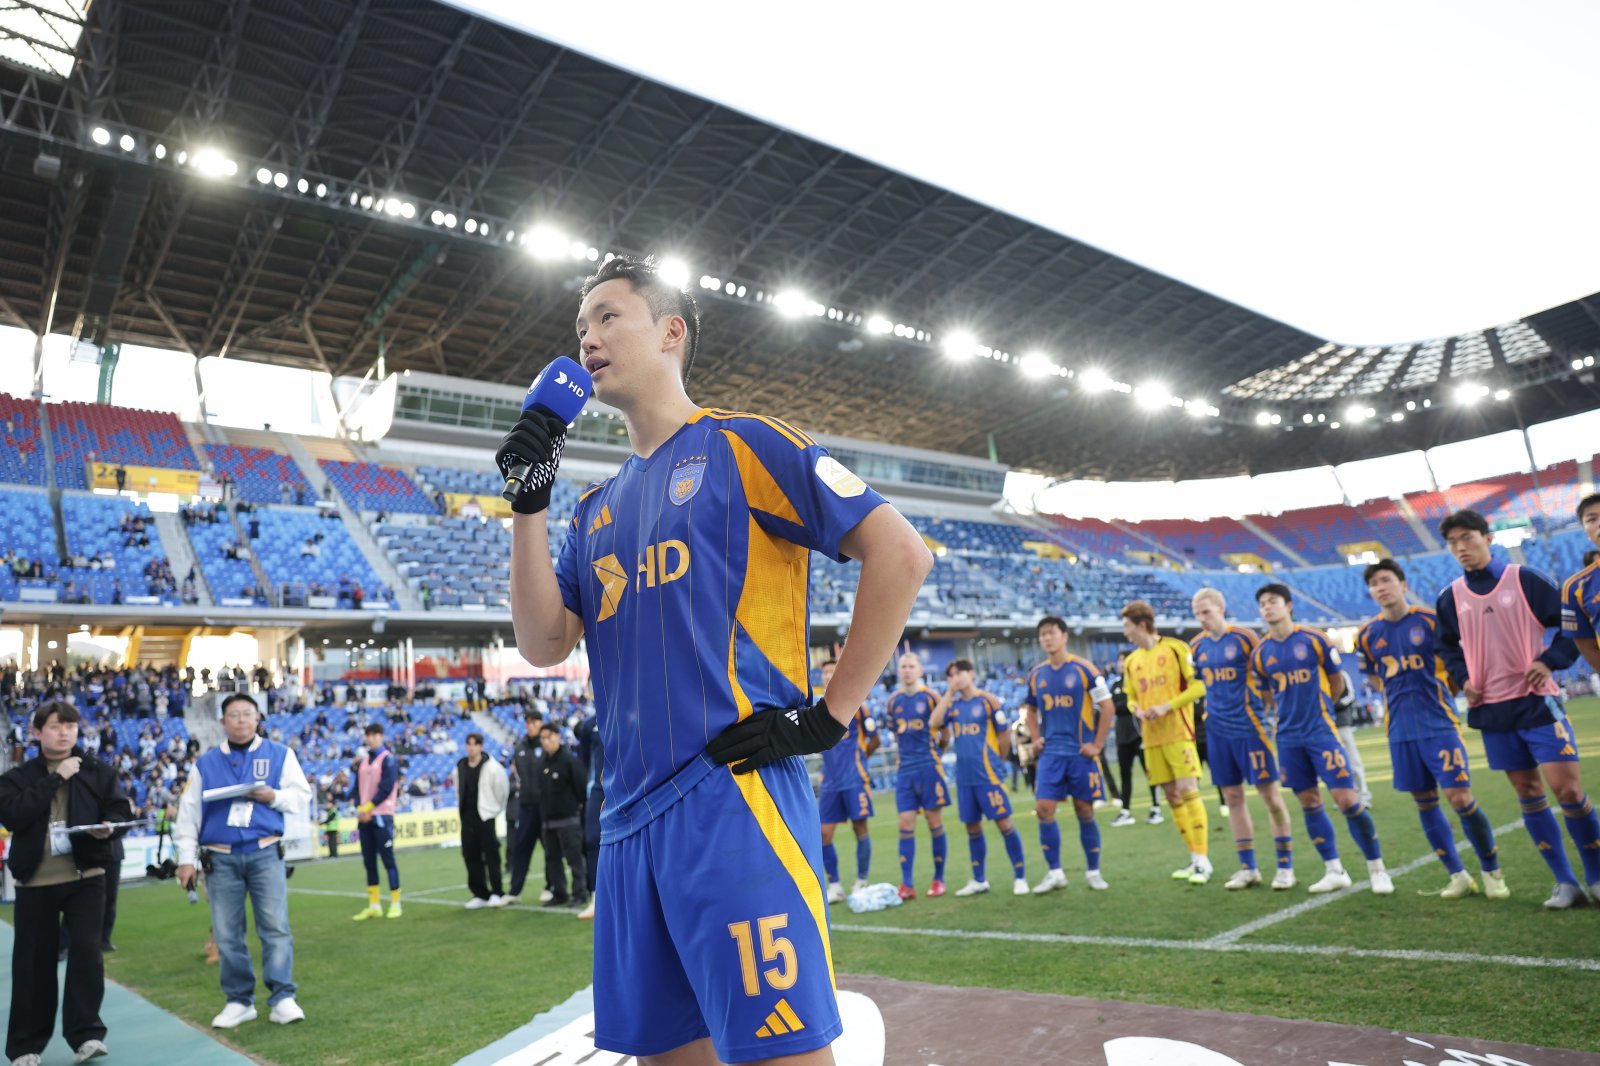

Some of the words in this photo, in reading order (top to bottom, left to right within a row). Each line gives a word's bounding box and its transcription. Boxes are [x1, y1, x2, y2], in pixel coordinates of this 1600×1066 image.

[568, 381, 584, 397] HD
[636, 539, 690, 593] HD
[1400, 654, 1424, 670] HD
[1215, 667, 1237, 681] HD
[1287, 669, 1311, 685] HD
[1055, 695, 1073, 707] HD
[961, 723, 980, 735] HD
[1249, 751, 1266, 770] 17
[1322, 749, 1346, 770] 26
[1439, 748, 1465, 771] 24
[253, 759, 269, 779] U
[859, 792, 868, 808] 5
[987, 790, 1003, 807] 16
[728, 913, 798, 996] 15
